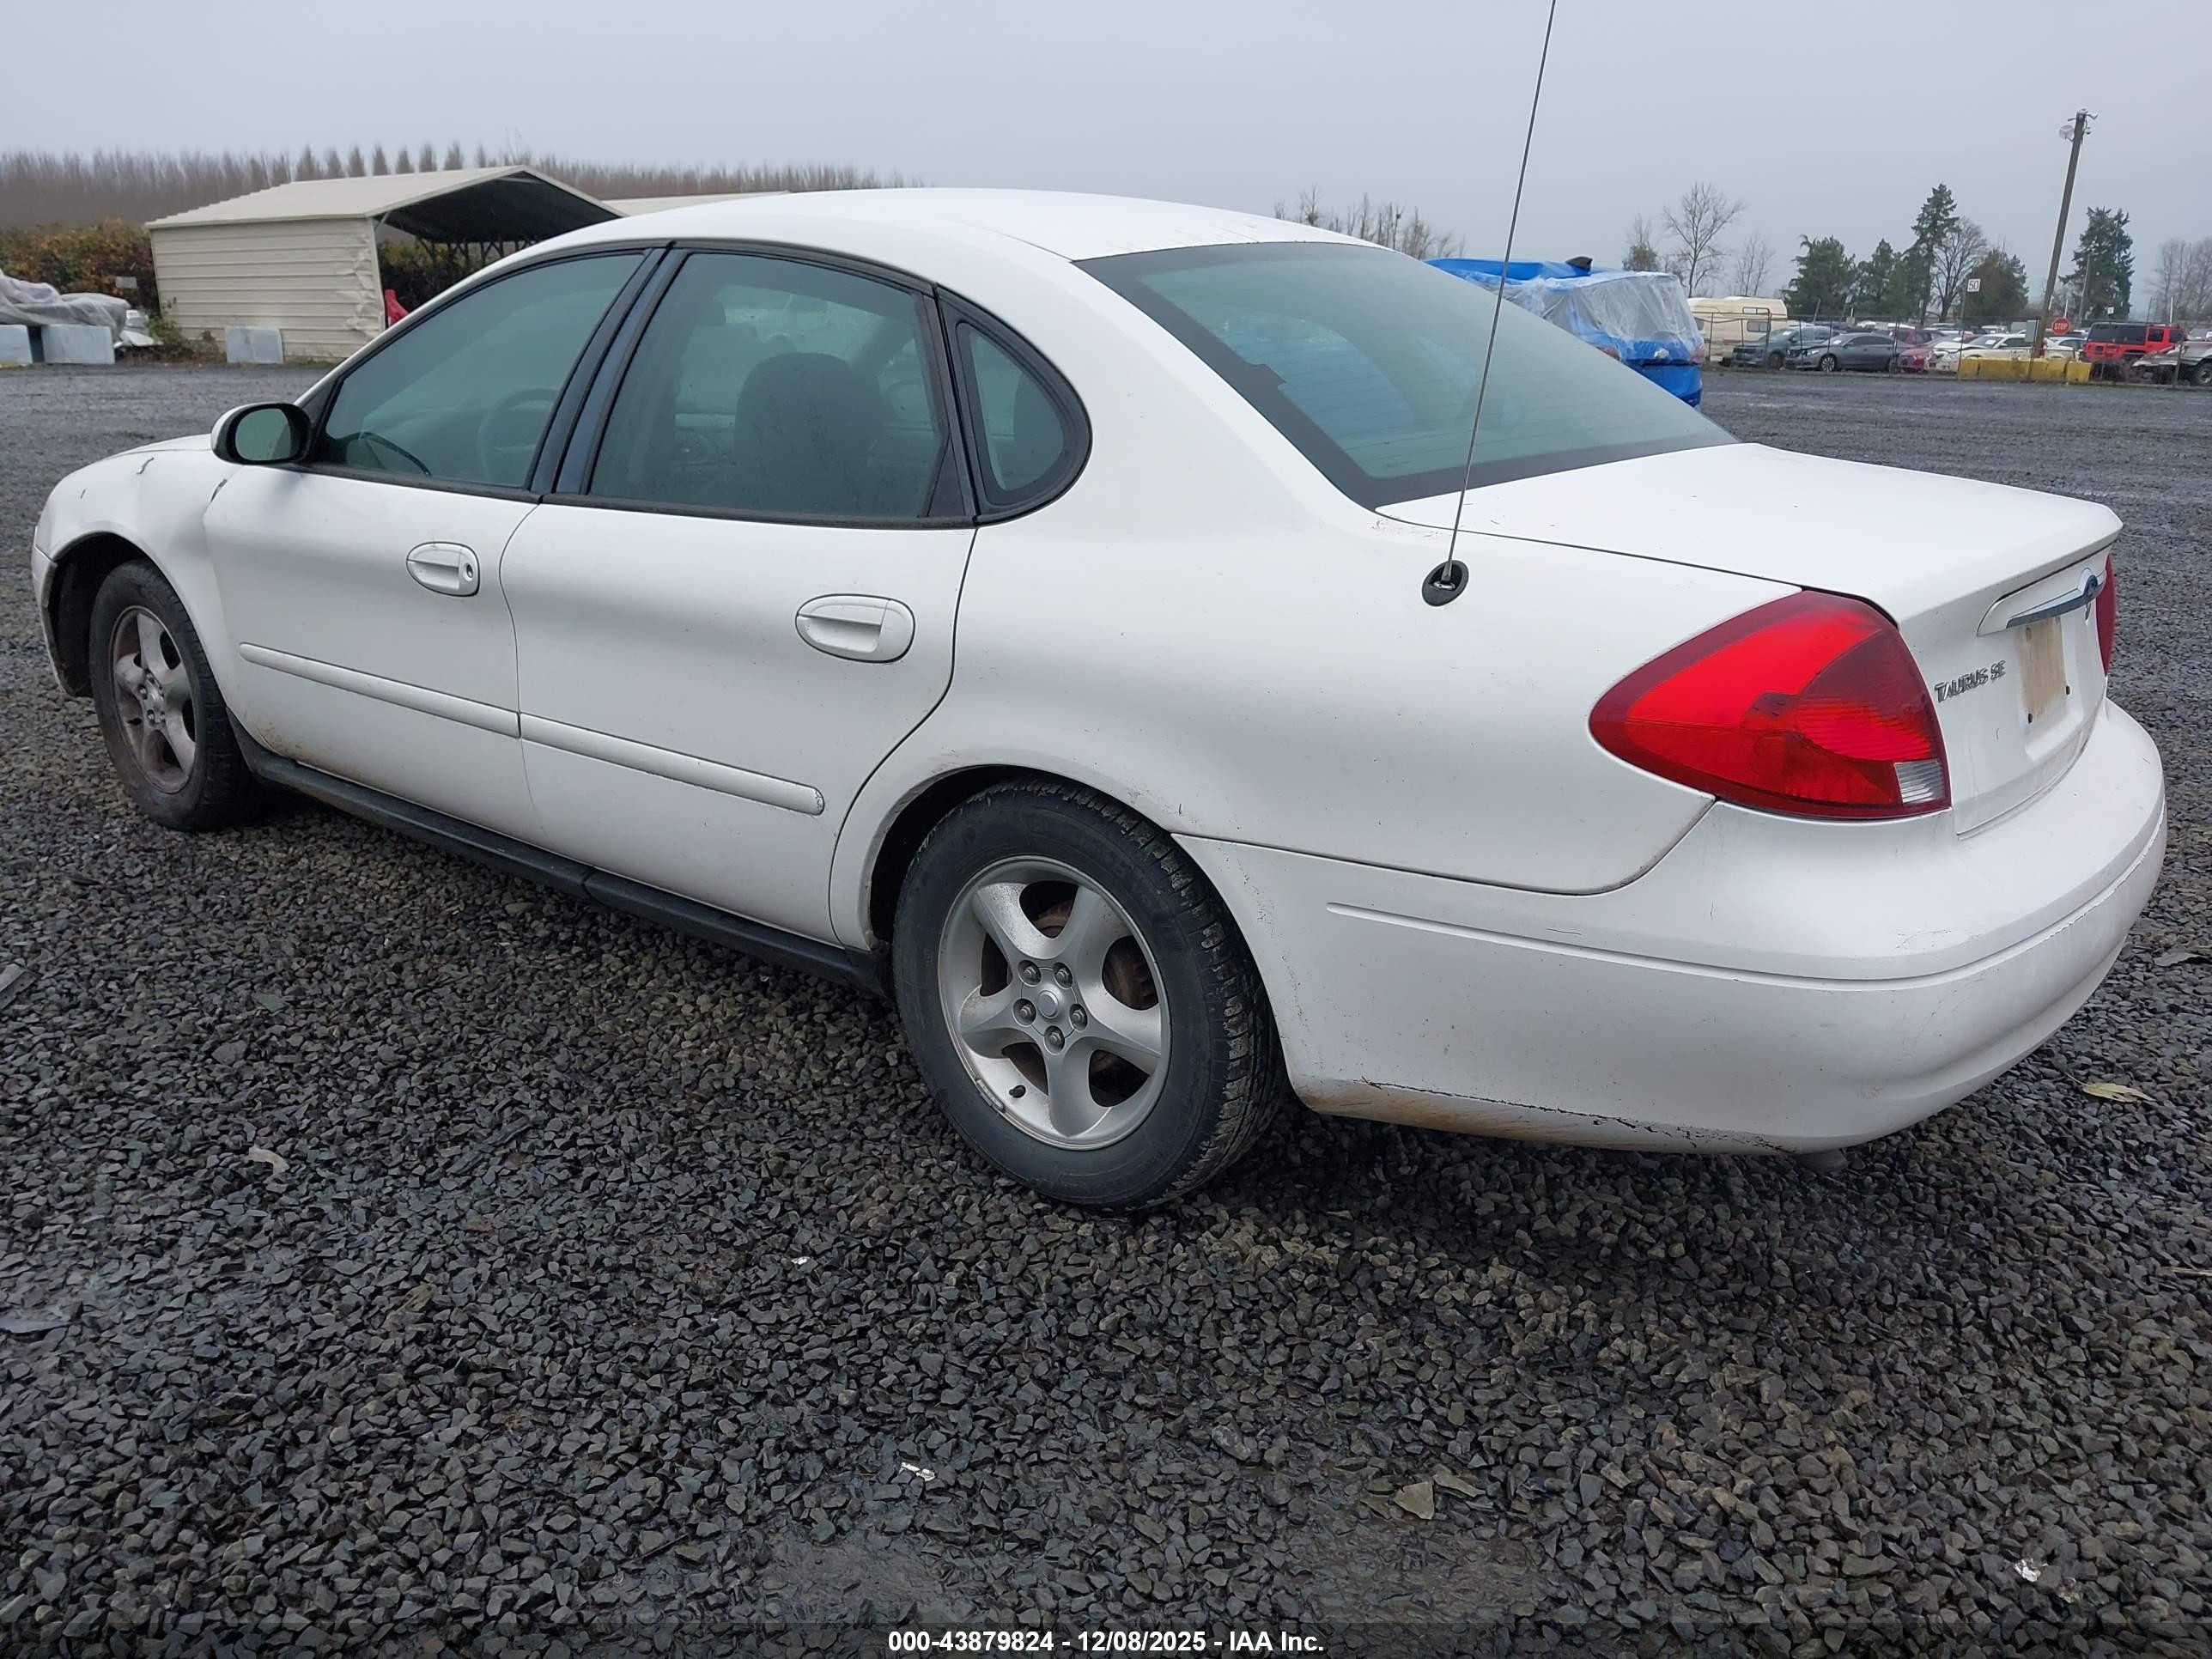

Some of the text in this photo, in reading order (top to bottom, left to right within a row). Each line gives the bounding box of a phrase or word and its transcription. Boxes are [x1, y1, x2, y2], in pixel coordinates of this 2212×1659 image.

[1969, 280, 1979, 290] 50
[1934, 659, 2006, 702] TAURUS SE
